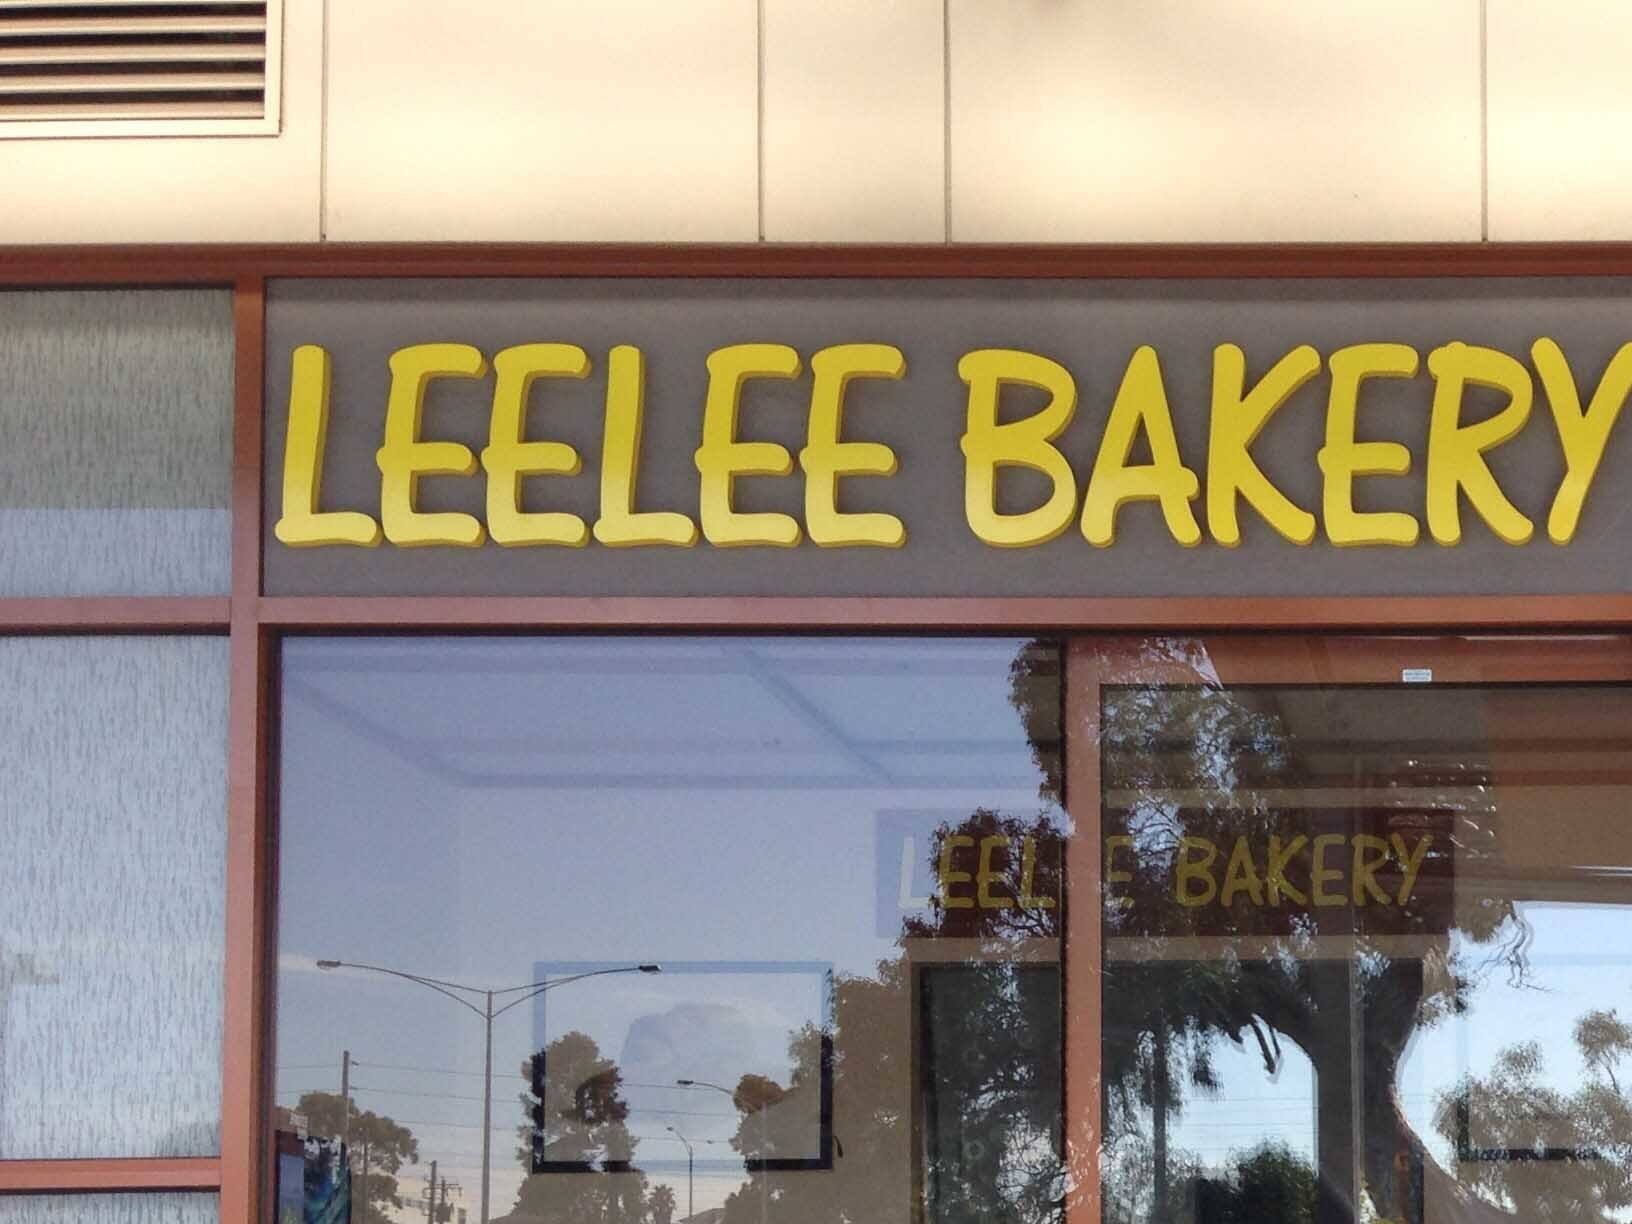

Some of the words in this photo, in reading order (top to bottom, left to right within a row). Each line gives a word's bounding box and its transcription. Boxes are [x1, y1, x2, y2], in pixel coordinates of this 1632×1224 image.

[274, 340, 908, 551] LEELEE
[897, 833, 1135, 909] LEELE
[1173, 832, 1434, 907] BAKERY
